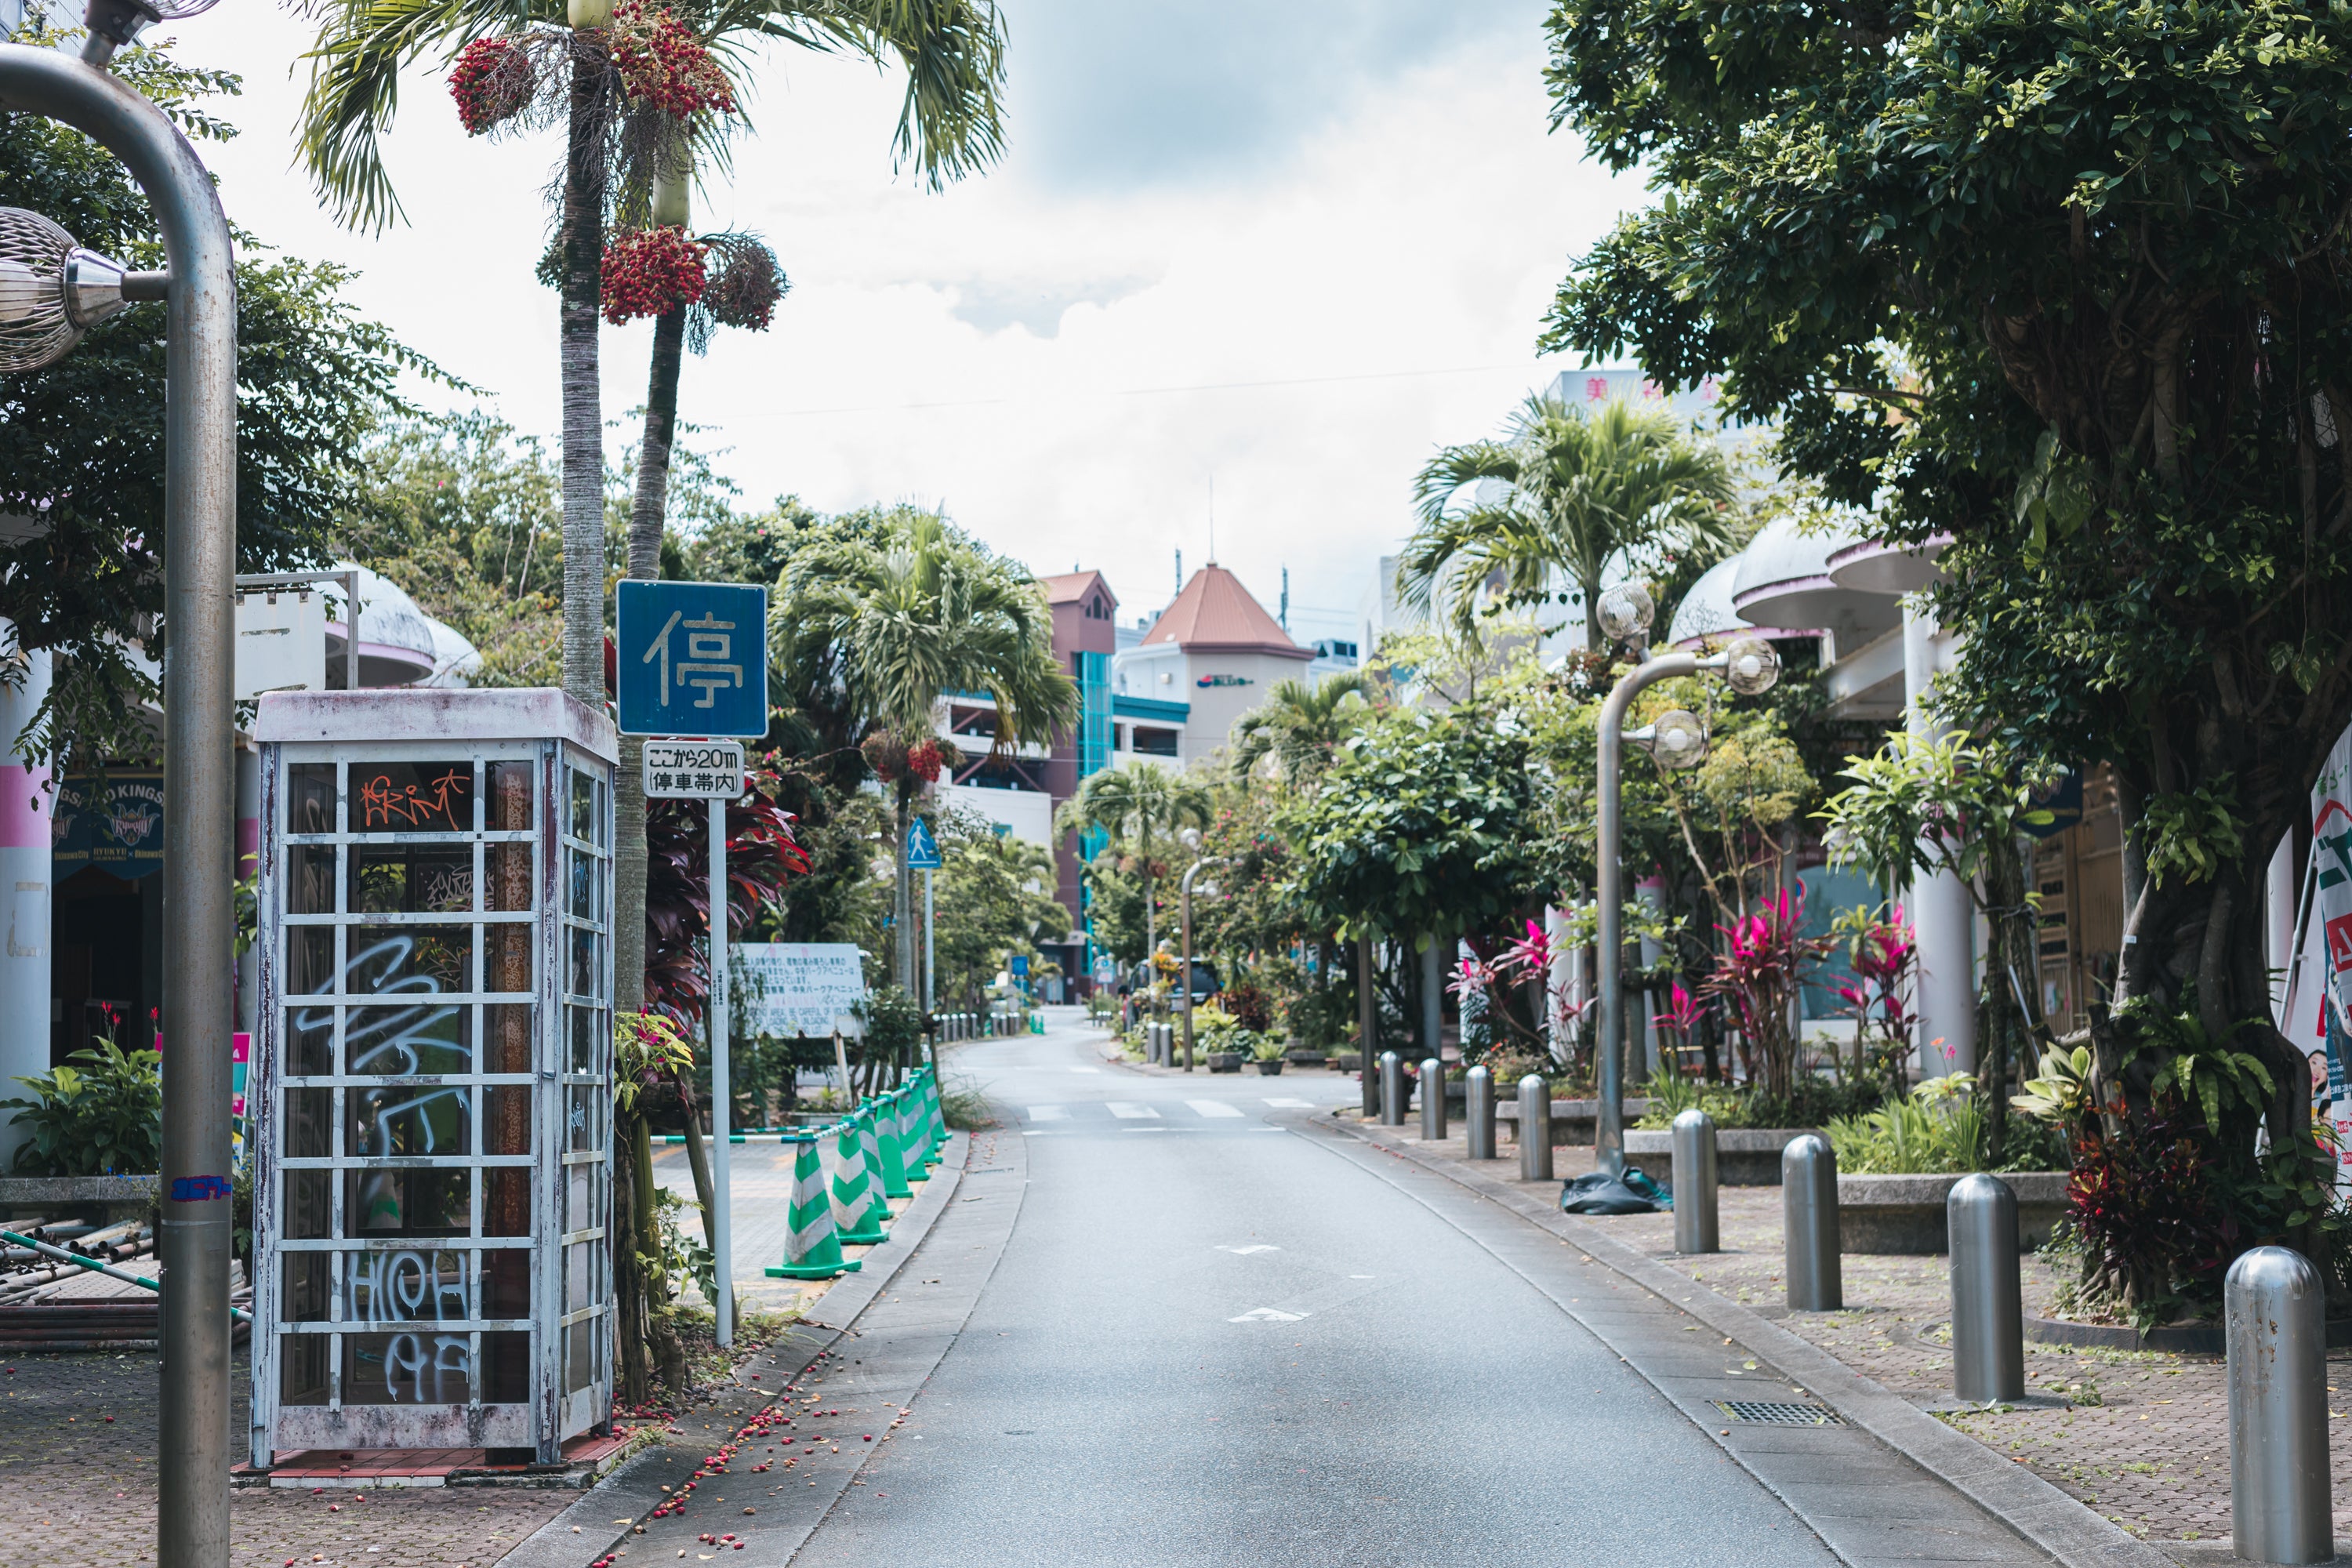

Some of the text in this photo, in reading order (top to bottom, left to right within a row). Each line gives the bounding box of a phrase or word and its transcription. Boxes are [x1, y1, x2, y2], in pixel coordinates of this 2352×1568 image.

[642, 610, 743, 708] 停
[649, 749, 738, 769] ここから20m
[649, 772, 738, 793] (停車帯内)
